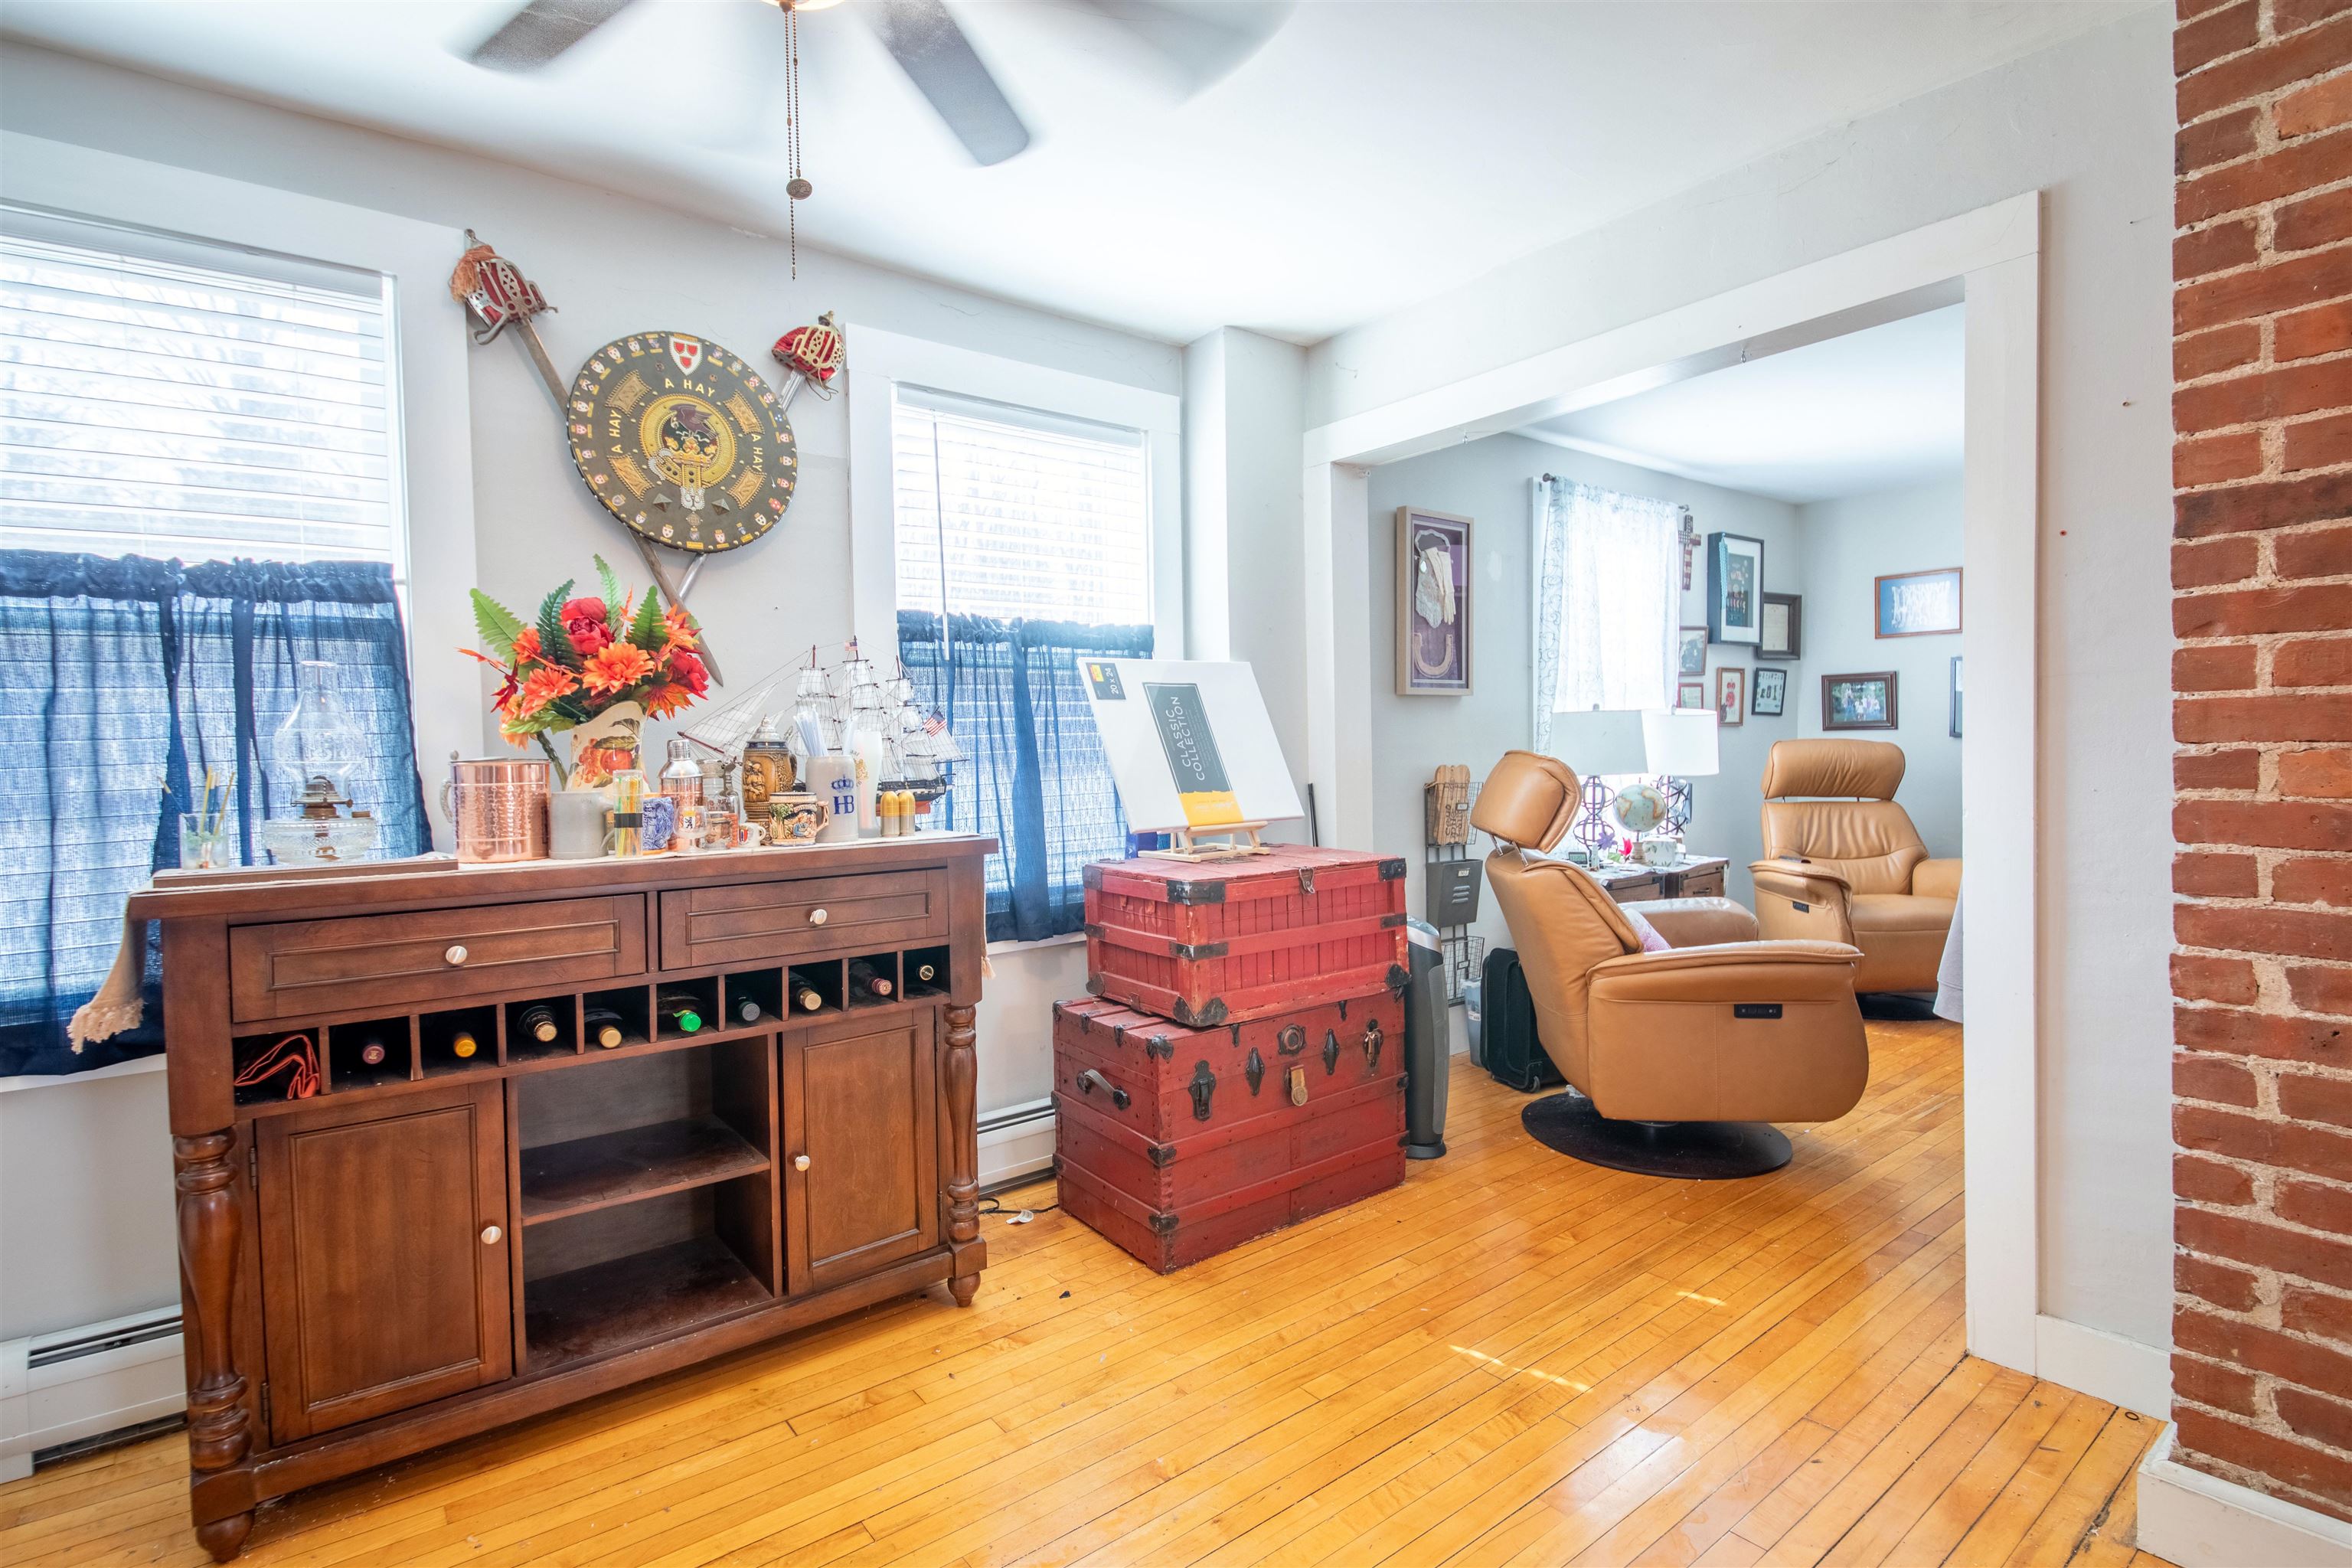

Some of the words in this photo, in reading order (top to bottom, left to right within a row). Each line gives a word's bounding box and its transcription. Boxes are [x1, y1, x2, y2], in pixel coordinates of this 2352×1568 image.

[665, 377, 674, 388] A
[683, 379, 716, 397] HAY
[609, 410, 622, 437] HAY
[751, 433, 762, 443] A
[611, 444, 623, 453] A
[753, 446, 763, 472] HAY
[1105, 668, 1113, 677] 24
[1110, 684, 1119, 694] 20
[1165, 710, 1191, 767] CLASSIC
[1171, 697, 1205, 781] COLLECTION
[833, 795, 854, 815] HB
